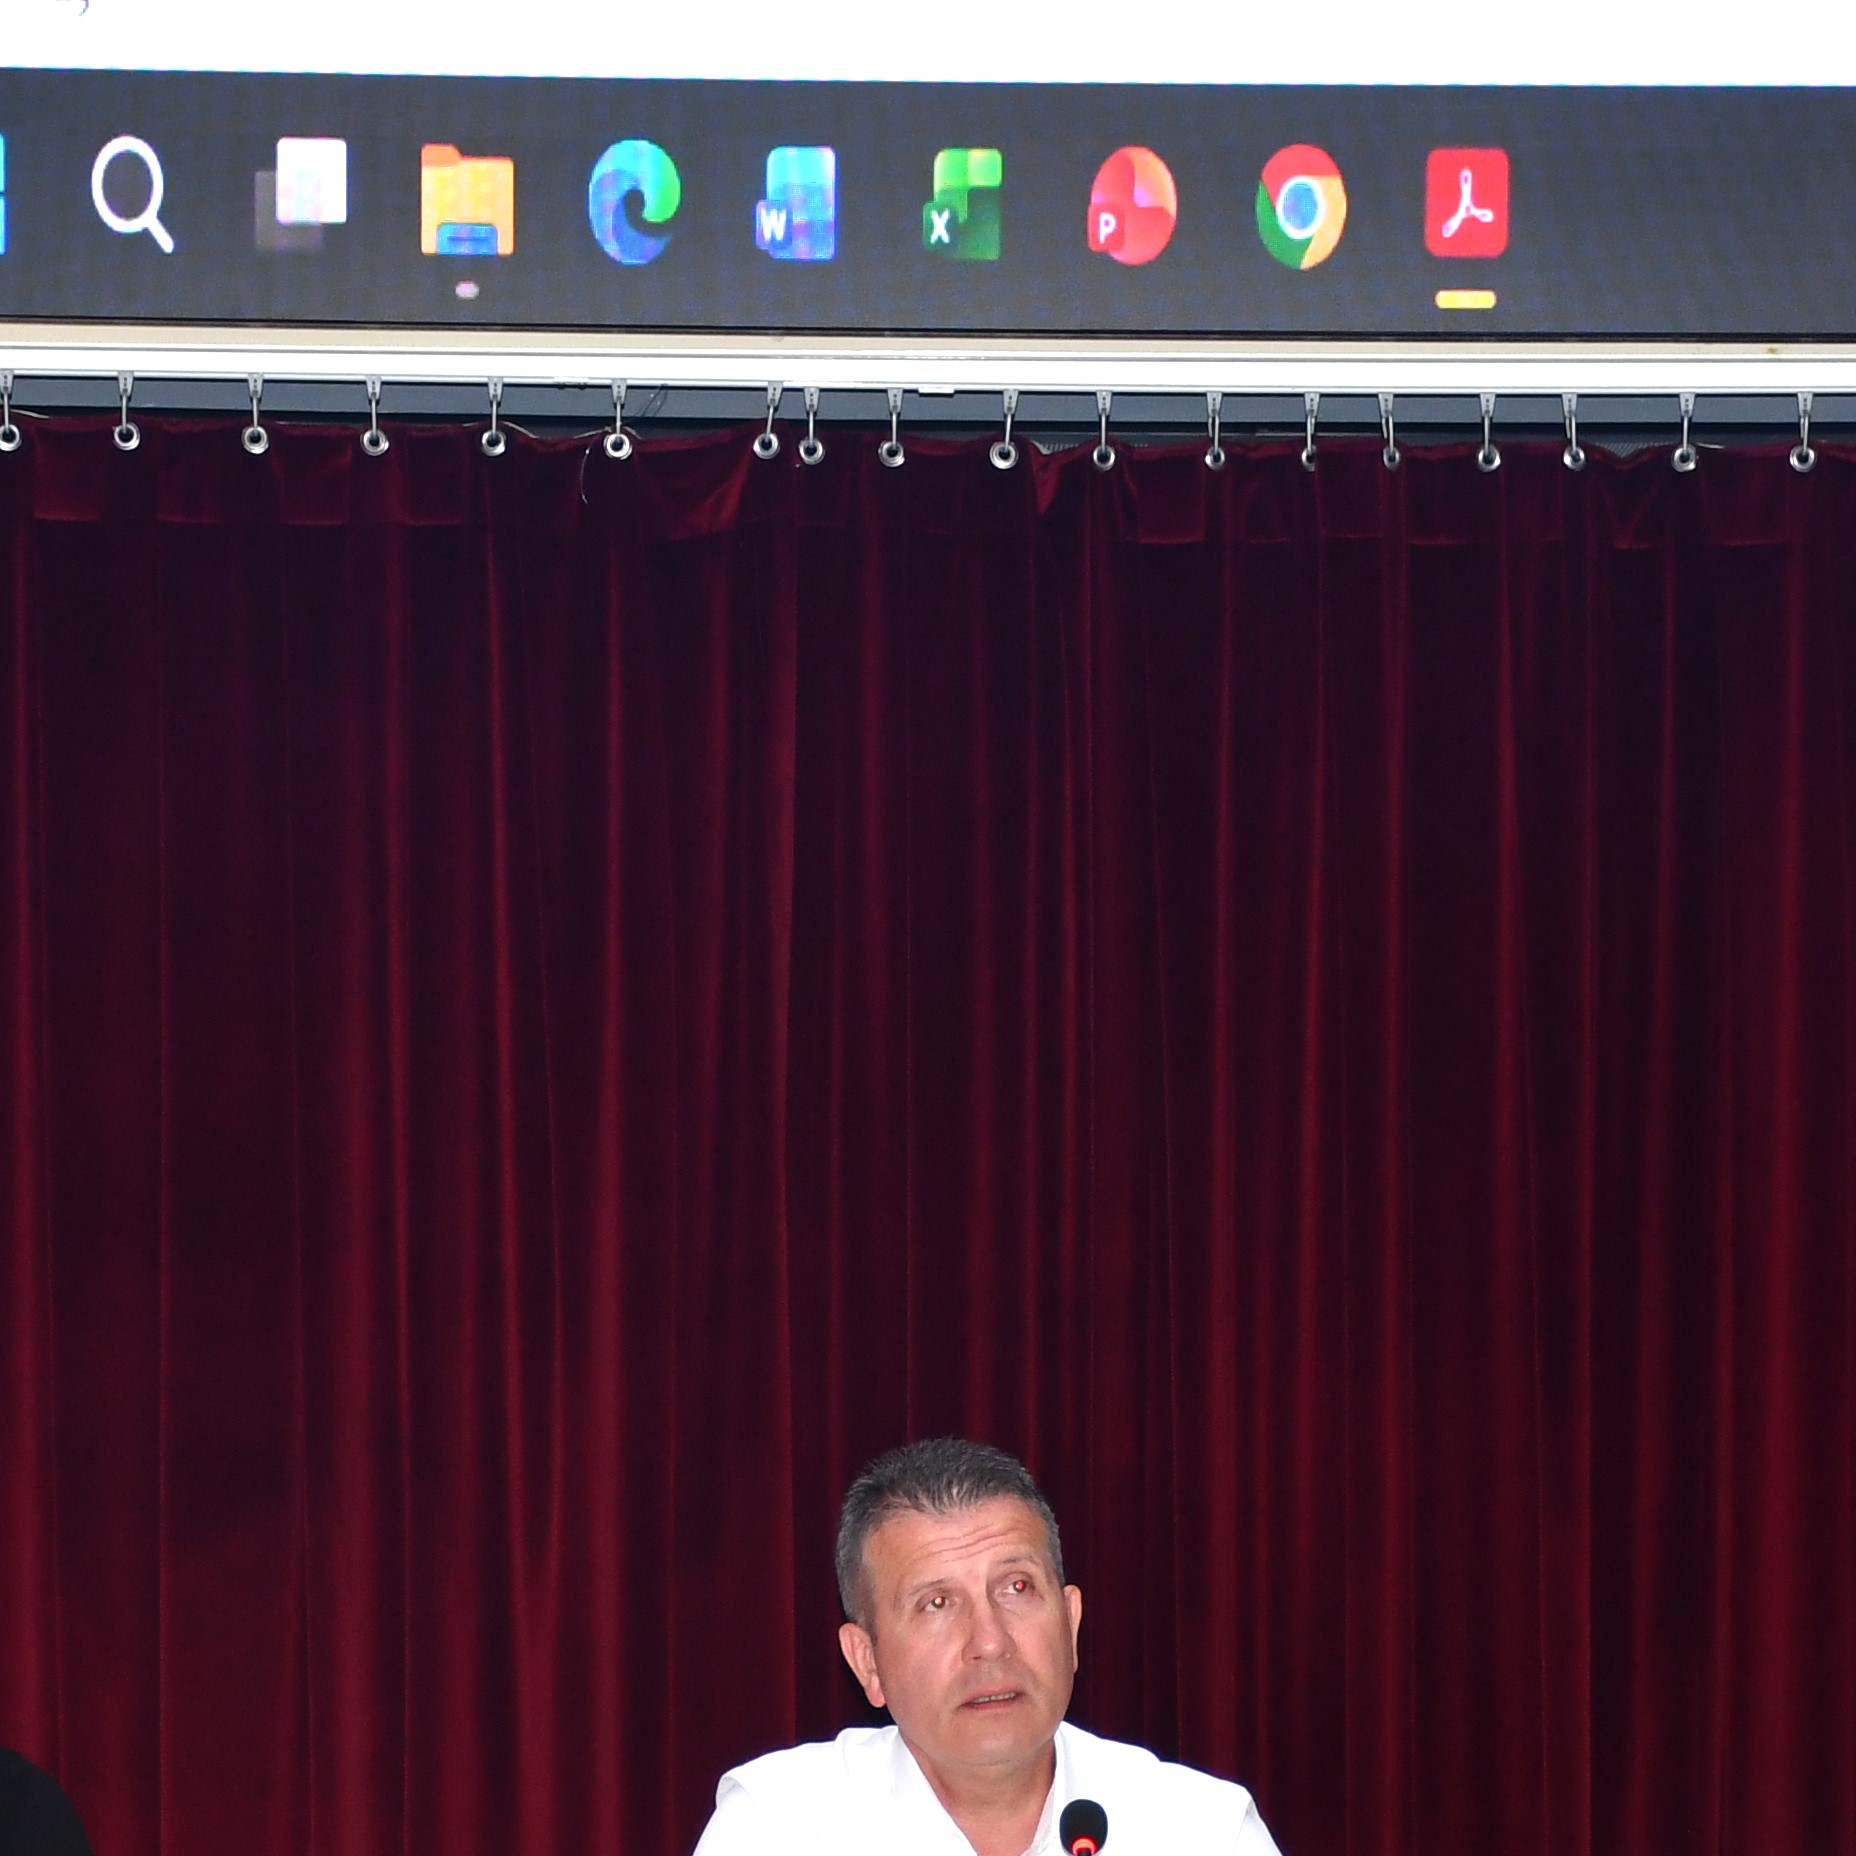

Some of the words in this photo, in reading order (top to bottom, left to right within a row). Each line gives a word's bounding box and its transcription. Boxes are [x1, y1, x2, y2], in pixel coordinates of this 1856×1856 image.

[759, 207, 787, 242] W
[930, 209, 949, 243] X
[1099, 212, 1116, 244] P
